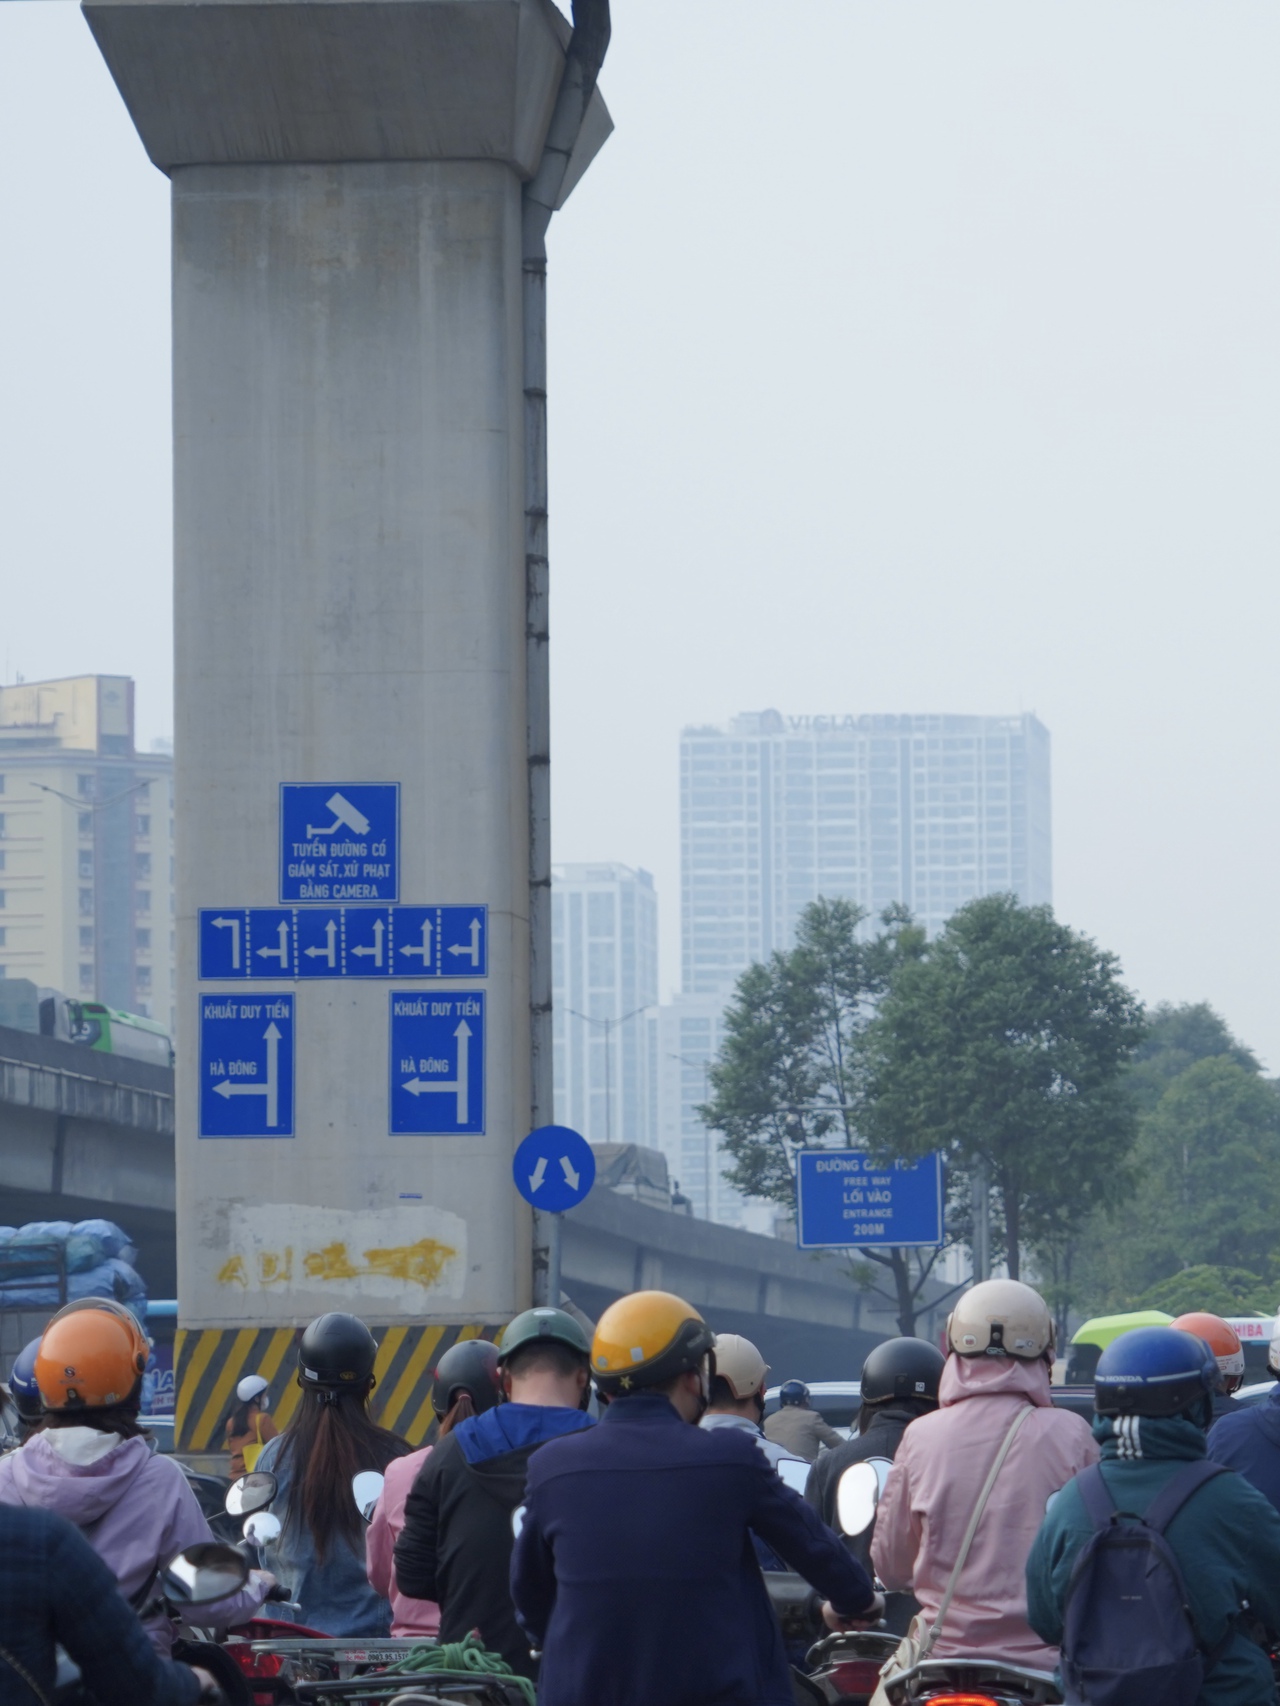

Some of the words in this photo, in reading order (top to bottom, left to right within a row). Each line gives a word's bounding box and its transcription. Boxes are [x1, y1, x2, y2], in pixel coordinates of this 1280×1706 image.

[292, 837, 327, 857] TUYẾN
[330, 839, 367, 857] ĐƯỜNG
[372, 839, 387, 857] CÓ
[288, 860, 315, 878] GIÁM
[363, 864, 391, 880] PHẠT
[300, 879, 329, 898] BẰNG
[333, 884, 379, 898] CAMERA
[204, 1000, 238, 1019] KHUẤT
[240, 1005, 261, 1019] DUY
[265, 999, 289, 1019] TIẾN
[394, 997, 428, 1016] KHUẤT
[431, 1002, 452, 1016] DUY
[456, 996, 480, 1016] TIẾN
[210, 1059, 225, 1076] HÀ
[229, 1060, 257, 1076] ĐÔNG
[400, 1056, 416, 1073] HÀ
[420, 1056, 449, 1073] ĐÔNG
[816, 1156, 859, 1173] ĐƯỜNG
[843, 1177, 868, 1186] FREE
[871, 1176, 892, 1186] WAY
[843, 1188, 864, 1204] LỐI
[867, 1188, 892, 1203] VÀO
[843, 1208, 893, 1219] ENTRANCE
[854, 1224, 885, 1236] 200M
[1234, 1324, 1263, 1336] HIBA
[1105, 1375, 1143, 1383] HONDA
